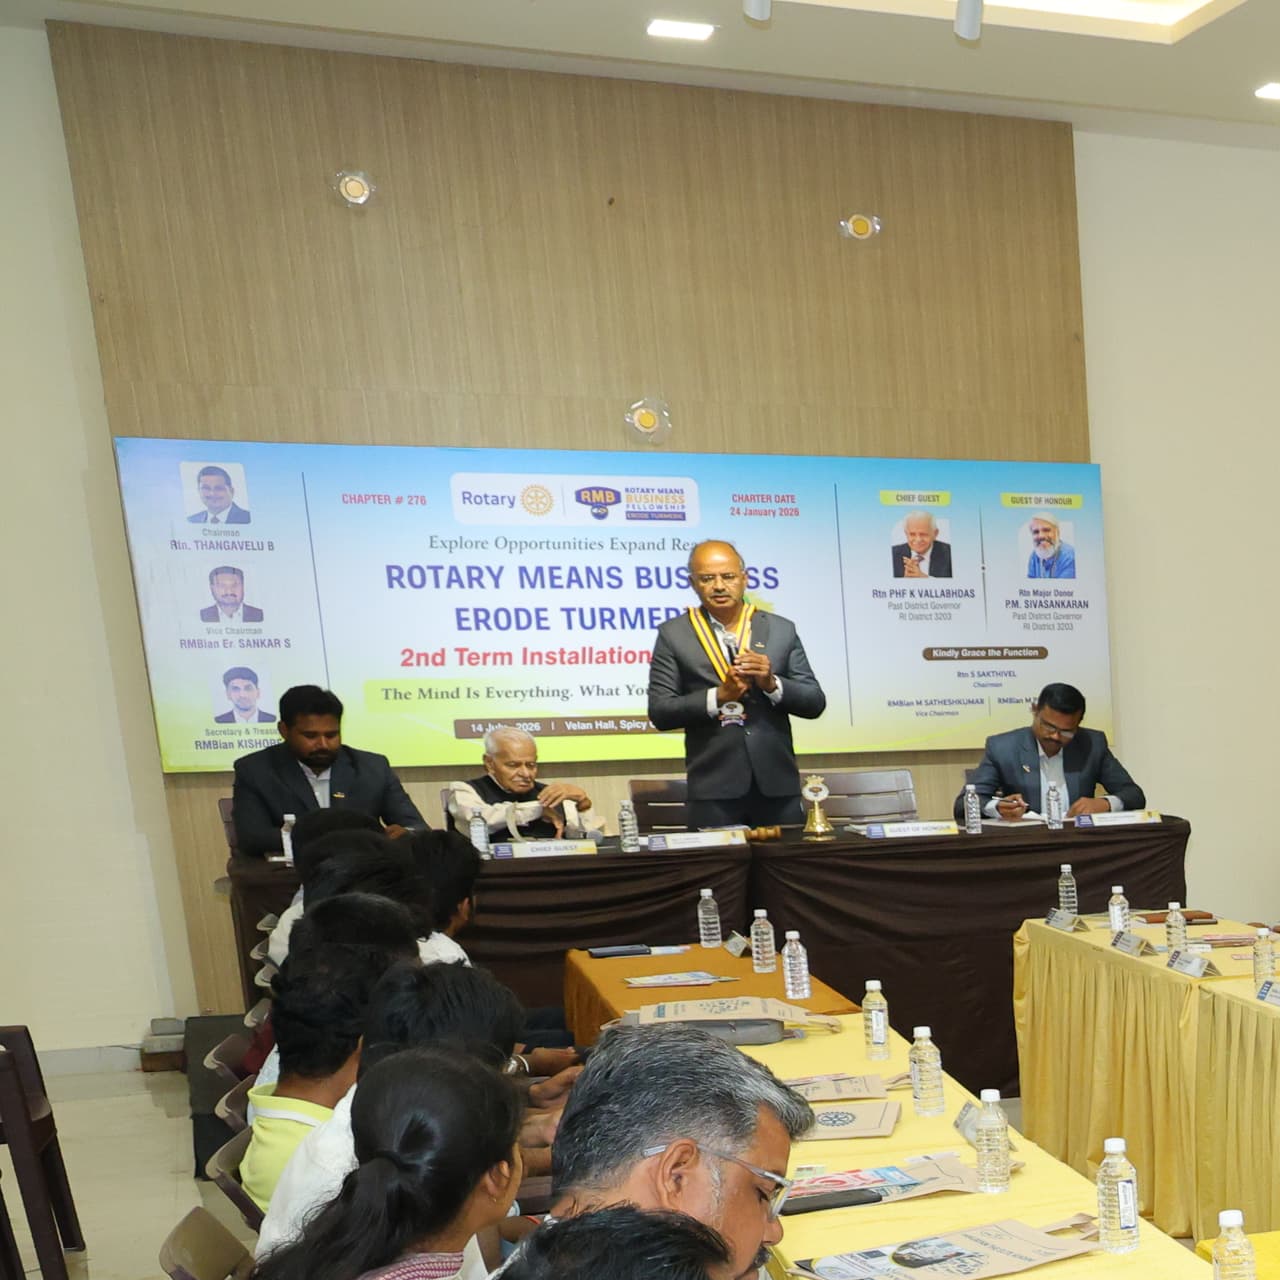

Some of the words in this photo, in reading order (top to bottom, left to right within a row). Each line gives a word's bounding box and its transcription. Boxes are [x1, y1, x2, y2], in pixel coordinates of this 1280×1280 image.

[341, 493, 391, 505] CHAPTER
[395, 496, 404, 505] #
[407, 495, 427, 506] 276
[462, 491, 516, 508] Rotary
[580, 489, 615, 504] RMB
[625, 494, 685, 504] BUSINESS
[732, 494, 772, 503] CHARTER
[774, 494, 796, 504] DATE
[896, 494, 916, 502] CHIEF
[918, 494, 940, 502] GUEST
[1011, 497, 1033, 505] GUEST
[1034, 497, 1043, 505] OF
[730, 507, 740, 516] 24
[741, 507, 776, 518] January
[778, 508, 800, 516] 2026
[194, 540, 264, 551] THANGAVELU
[268, 541, 275, 552] B
[429, 535, 489, 554] Explore
[494, 535, 604, 555] Opportunities
[610, 537, 666, 555] Expand
[386, 565, 504, 589] ROTARY
[518, 566, 623, 590] MEANS
[636, 566, 779, 590] BUSSS
[889, 589, 907, 598] PHF
[909, 589, 916, 598] K
[918, 589, 975, 599] VALLABHDAS
[1005, 600, 1022, 609] P.M.
[1024, 599, 1089, 609] SIVASANKARAN
[455, 608, 551, 631] ERODE
[180, 639, 220, 649] RMBian
[238, 638, 282, 648] SANKAR
[284, 638, 291, 648] S
[400, 648, 446, 667] 2nd
[454, 648, 513, 666] Term
[522, 647, 653, 666] Installation
[932, 648, 960, 659] Kindly
[961, 648, 986, 657] Grace
[988, 648, 1001, 657] the
[1003, 648, 1039, 657] Function
[381, 688, 415, 701] The
[417, 687, 461, 701] Mind
[466, 687, 480, 700] Is
[485, 686, 574, 702] Everything.
[580, 685, 621, 697] What
[471, 723, 483, 733] 14
[564, 720, 593, 731] Velan
[595, 719, 618, 731] Hall,
[619, 719, 647, 731] Spicy
[195, 739, 235, 750] RMBian
